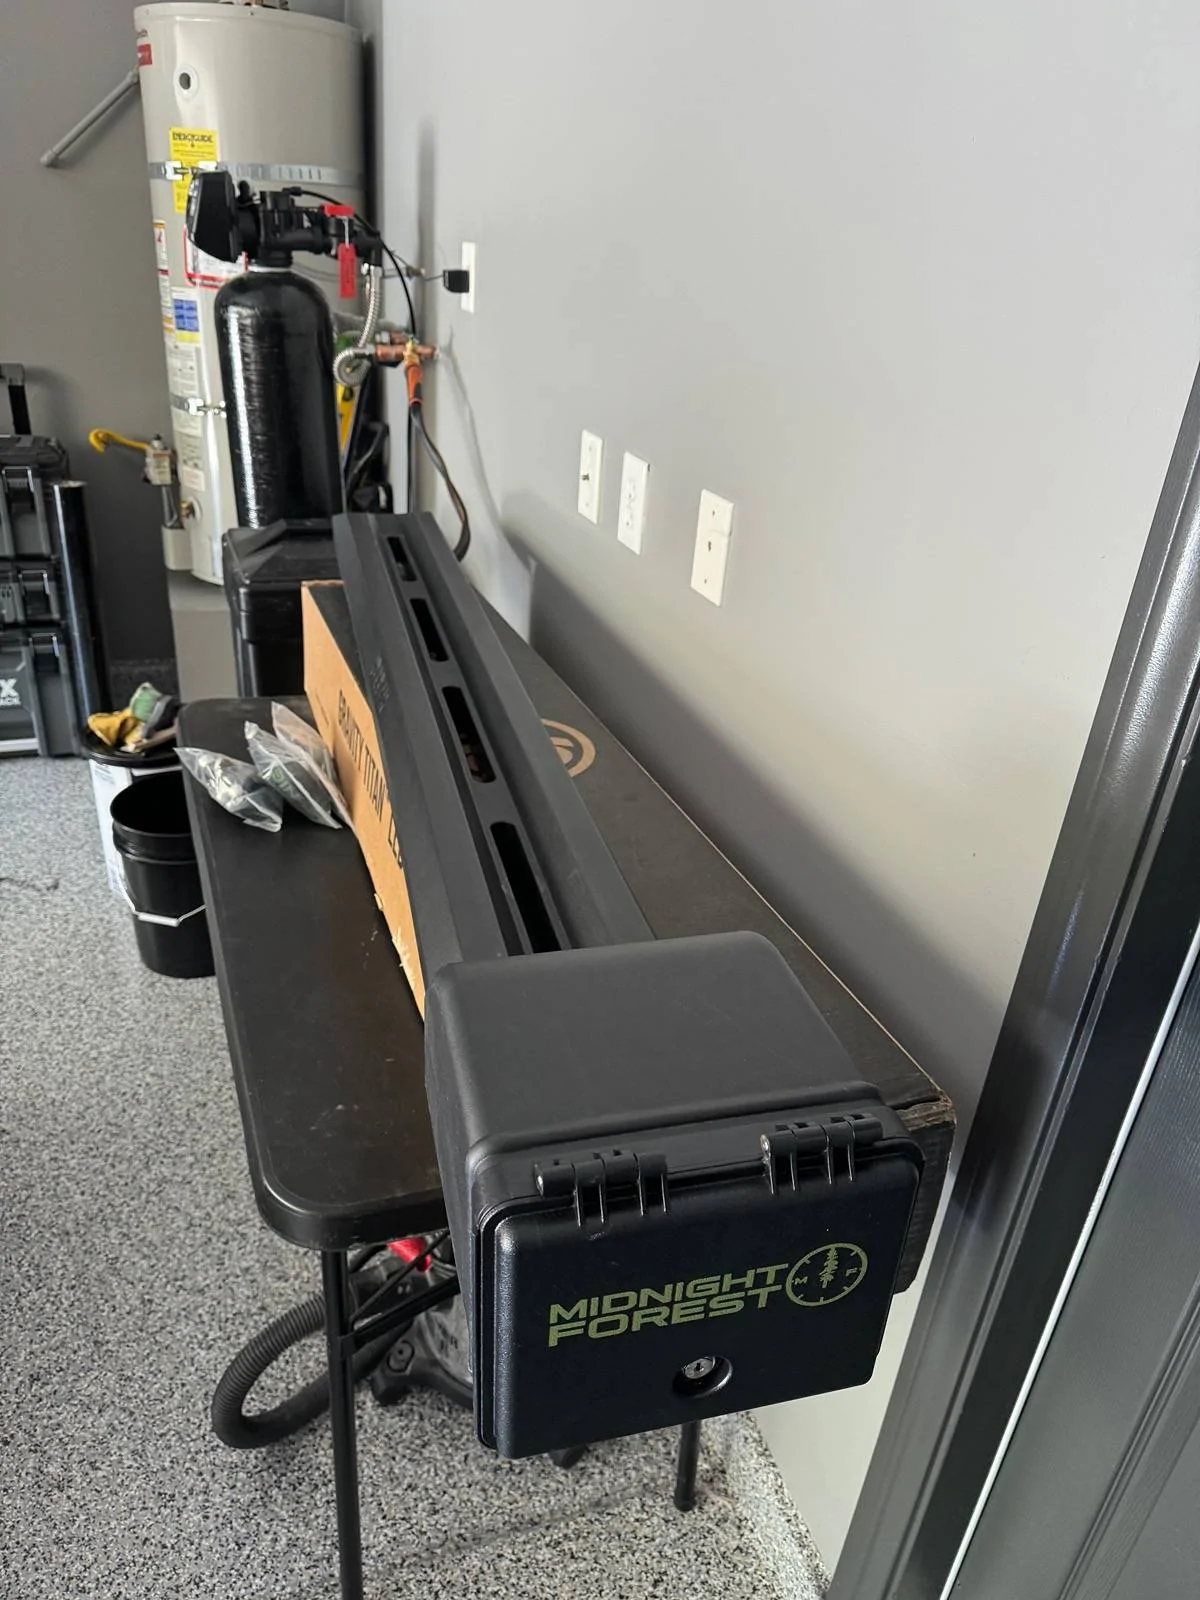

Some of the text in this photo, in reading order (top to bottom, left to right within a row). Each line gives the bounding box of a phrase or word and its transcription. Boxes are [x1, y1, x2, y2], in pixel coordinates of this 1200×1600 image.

[364, 743, 385, 823] TITAN
[549, 1284, 782, 1347] FOREST
[550, 1263, 789, 1325] MIDNIGHT
